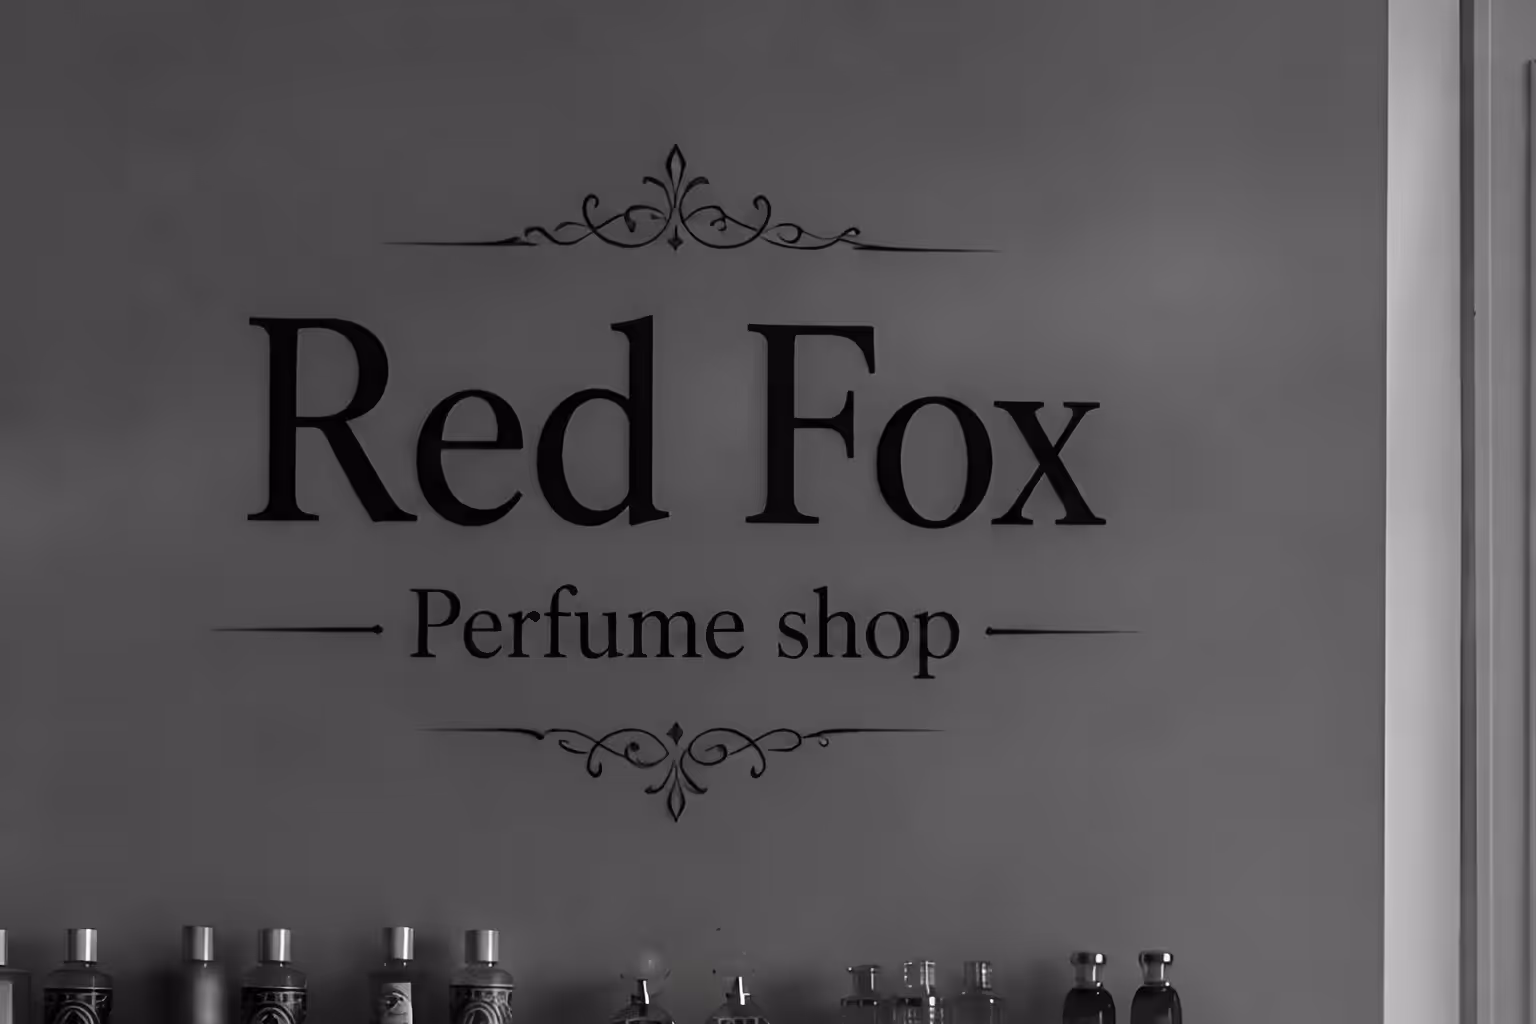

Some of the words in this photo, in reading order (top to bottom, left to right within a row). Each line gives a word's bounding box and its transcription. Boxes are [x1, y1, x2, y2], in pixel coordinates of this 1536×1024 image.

[246, 314, 670, 527] Red
[745, 323, 1107, 530] Fox
[409, 583, 745, 660] Perfume
[776, 585, 960, 680] shop
